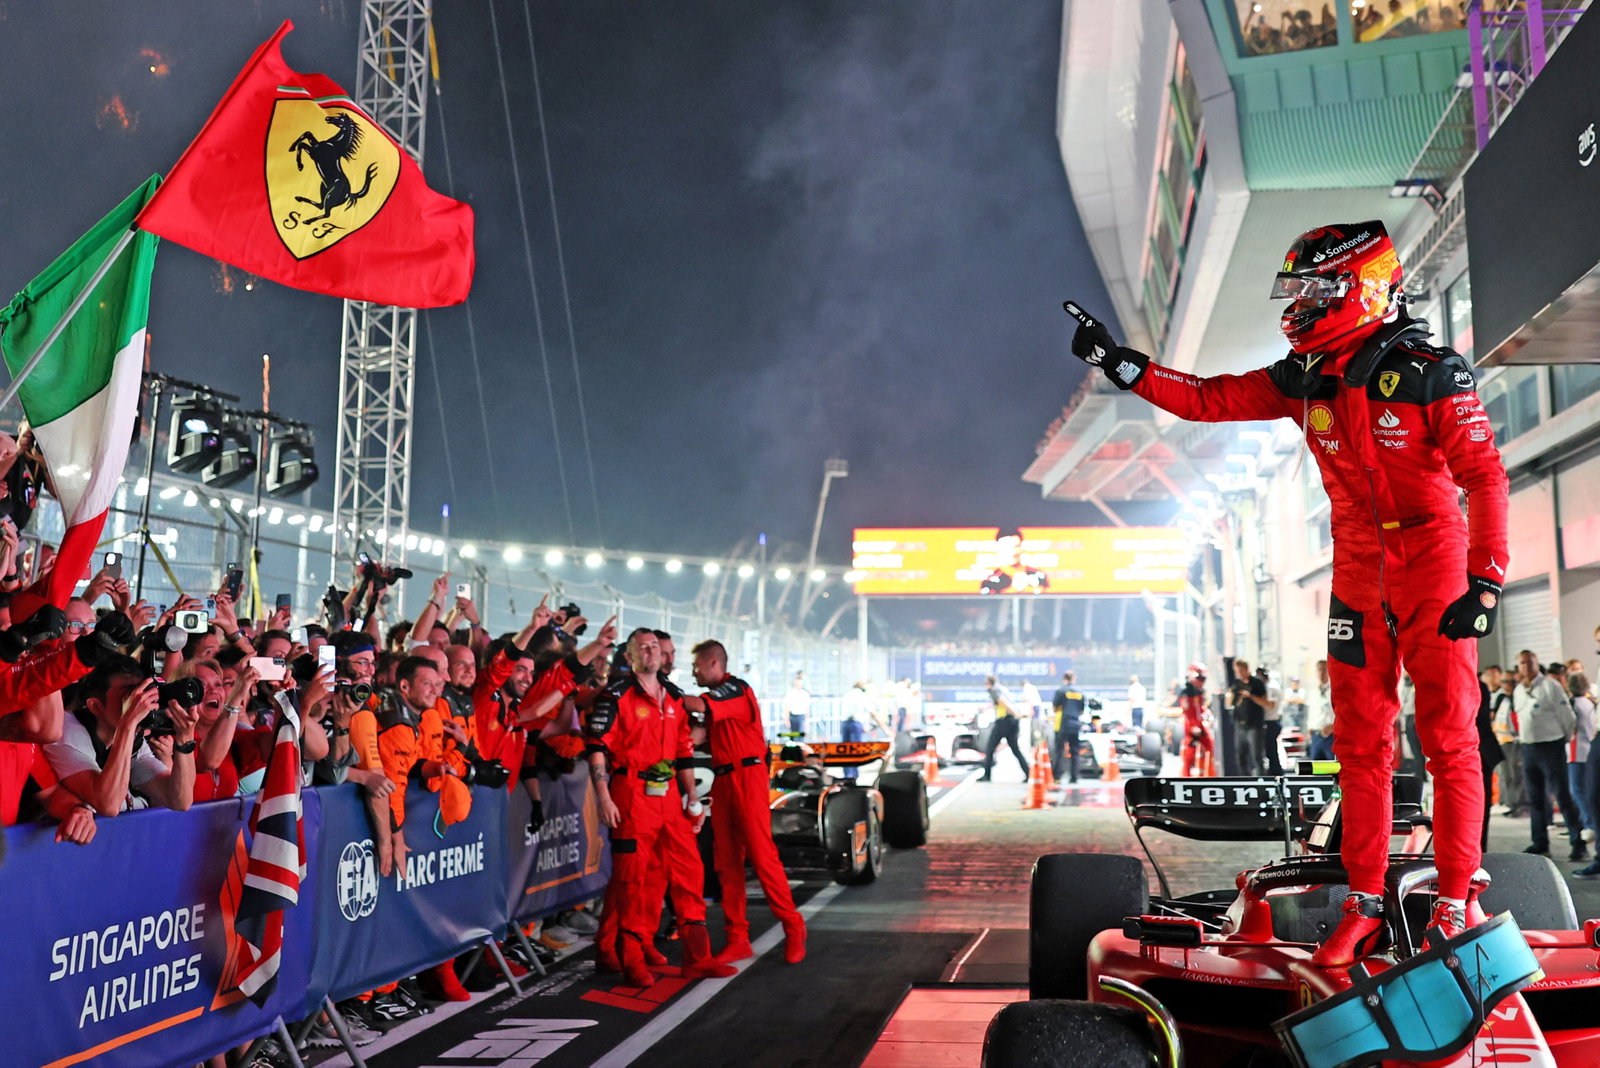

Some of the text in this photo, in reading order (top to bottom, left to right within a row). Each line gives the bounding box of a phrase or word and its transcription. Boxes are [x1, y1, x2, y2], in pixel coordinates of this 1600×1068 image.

[1578, 123, 1596, 155] aws
[1326, 230, 1371, 257] Santander
[1453, 371, 1473, 382] aws
[1372, 428, 1409, 436] Santander
[1328, 618, 1354, 641] 55
[924, 661, 1049, 676] SINGAPORE AIRLINES
[439, 831, 485, 881] FERMÉ
[49, 902, 206, 982] SINGAPORE
[1180, 970, 1234, 986] HARMAN
[78, 952, 202, 1030] AIRLINES
